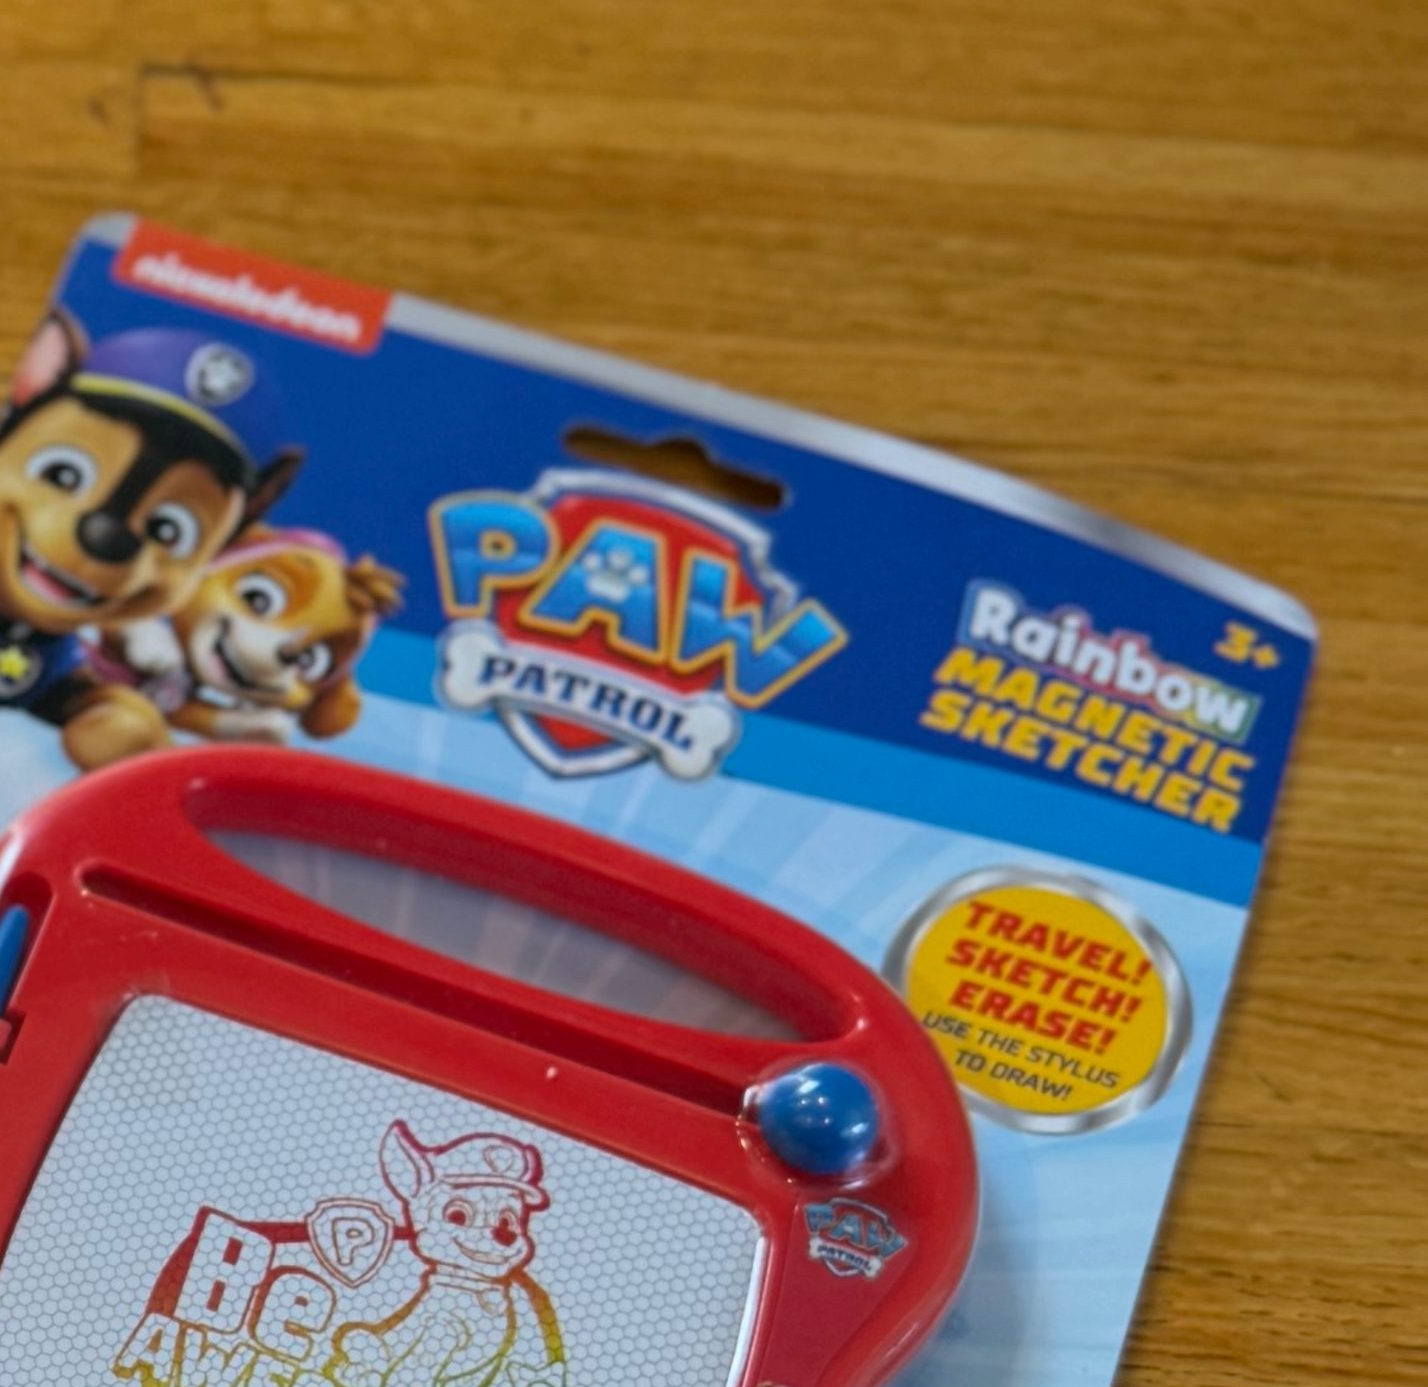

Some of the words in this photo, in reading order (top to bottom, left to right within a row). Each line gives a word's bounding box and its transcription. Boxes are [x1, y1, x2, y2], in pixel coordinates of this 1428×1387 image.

[428, 490, 847, 709] PAW
[969, 587, 1250, 733] Rainbow
[1214, 621, 1280, 669] 3+
[477, 655, 694, 751] PATROL
[933, 646, 1255, 791] MAGNETIC
[919, 689, 1241, 834] SKETCHER
[945, 938, 1143, 1023] SKETCH!
[965, 901, 1153, 985] TRAVEL!
[921, 1010, 973, 1041] USE
[978, 1028, 1023, 1057] THE
[1025, 1045, 1122, 1089] STYLUS
[948, 980, 1118, 1056] ERASE!
[955, 1050, 986, 1073] TO
[990, 1062, 1074, 1101] DRAW!
